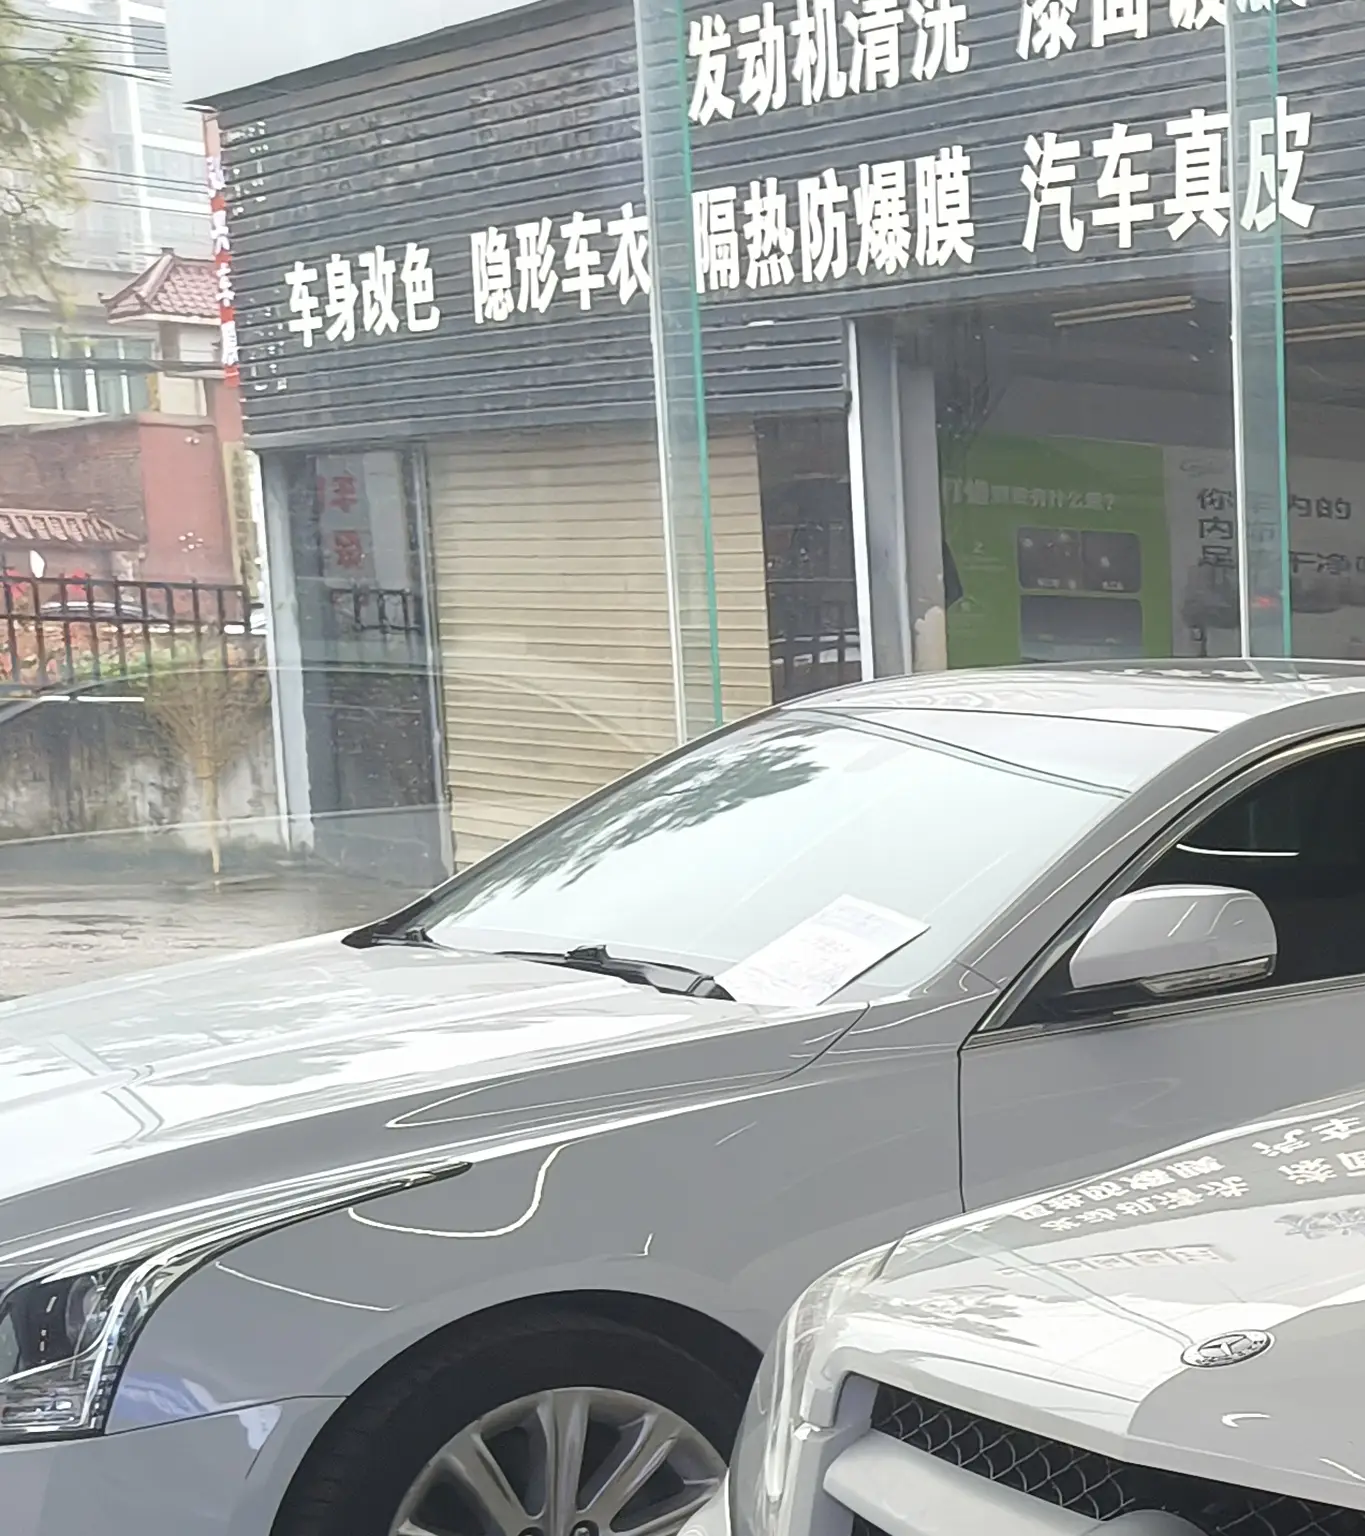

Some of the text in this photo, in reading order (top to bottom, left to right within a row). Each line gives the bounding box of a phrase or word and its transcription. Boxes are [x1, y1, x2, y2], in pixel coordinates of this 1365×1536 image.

[687, 0, 971, 127] 发动机清洗
[283, 241, 441, 348] 车身改色
[470, 202, 651, 324] 隐形车衣
[691, 144, 976, 294] 隔热防爆膜
[1020, 97, 1315, 253] 汽车真皮
